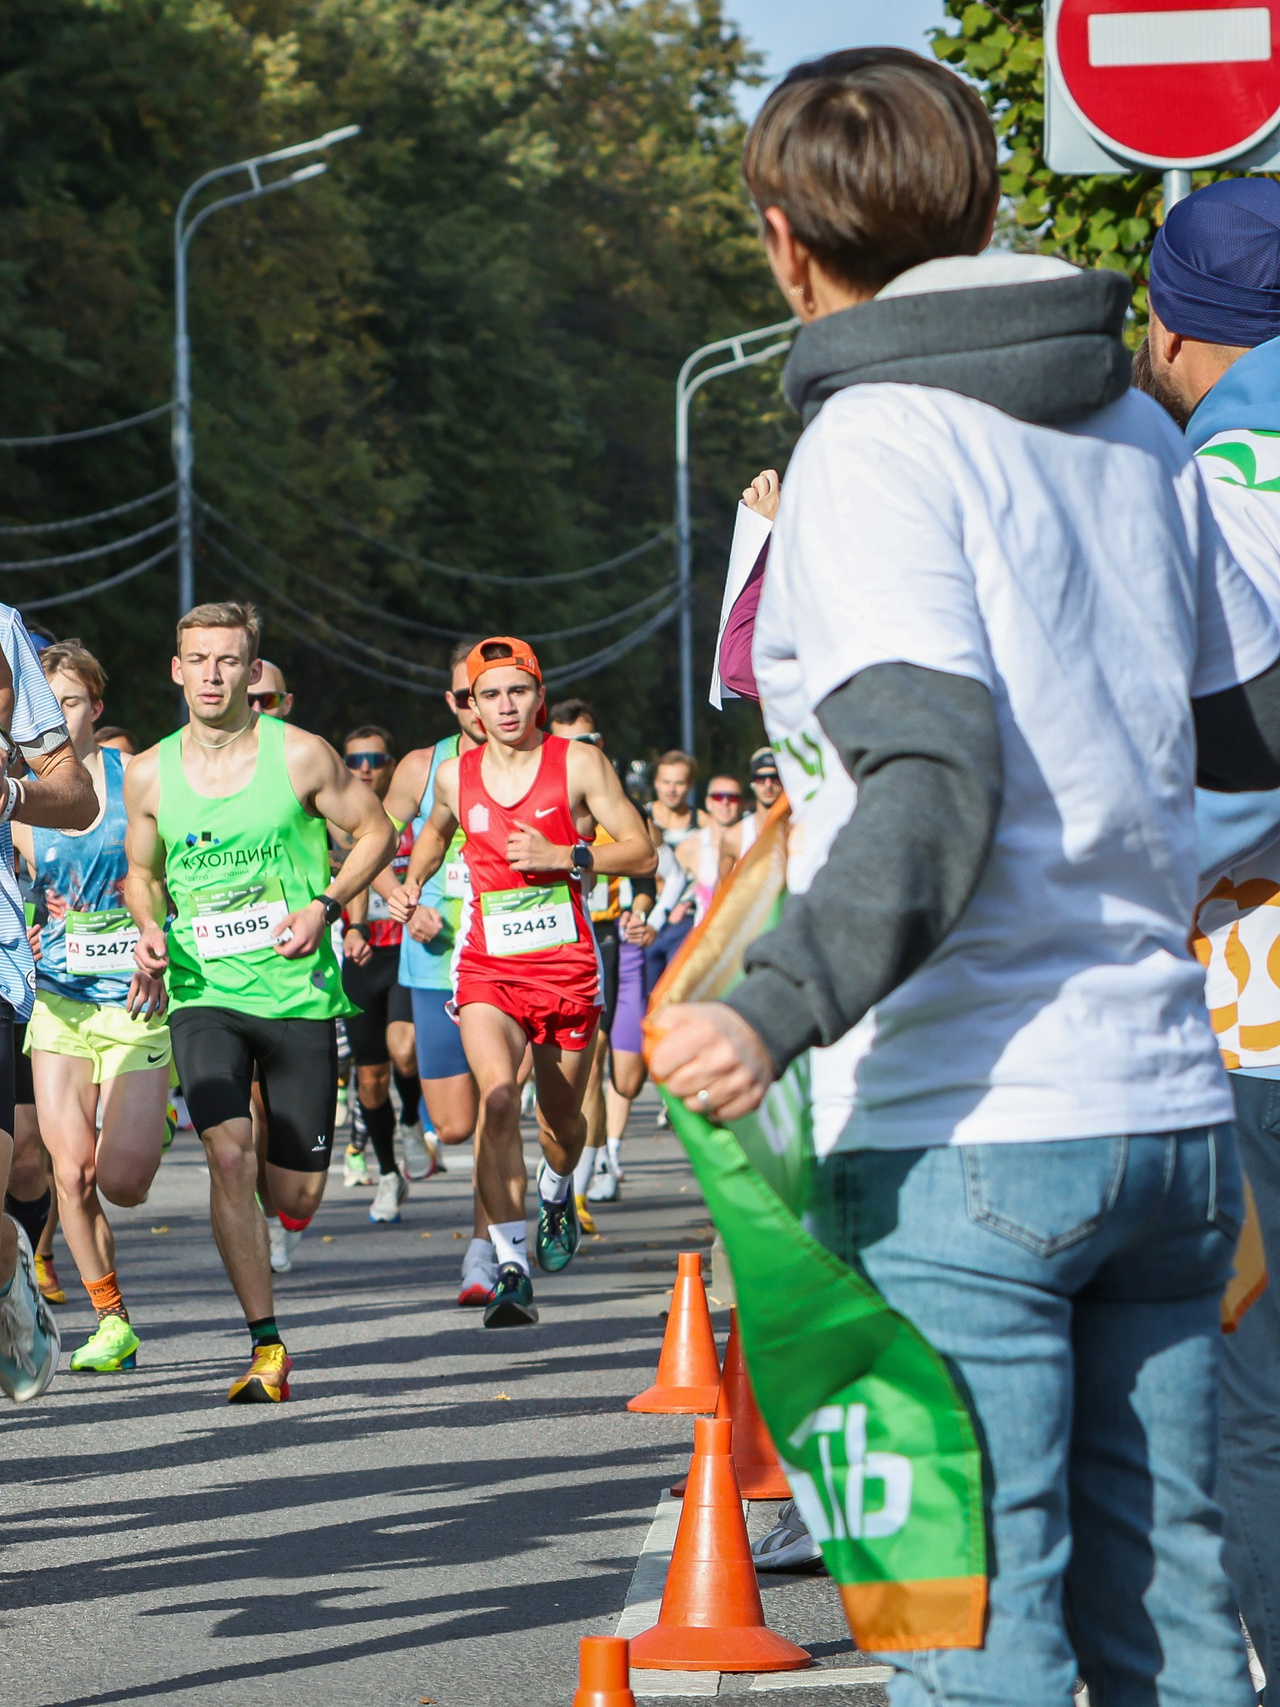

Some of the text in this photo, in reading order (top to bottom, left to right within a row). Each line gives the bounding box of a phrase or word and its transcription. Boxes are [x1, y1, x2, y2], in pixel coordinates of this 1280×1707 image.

[181, 844, 282, 870] К-ХОЛДИНГ
[214, 915, 270, 938] 51695
[502, 915, 557, 936] 52443
[85, 940, 138, 957] 52472
